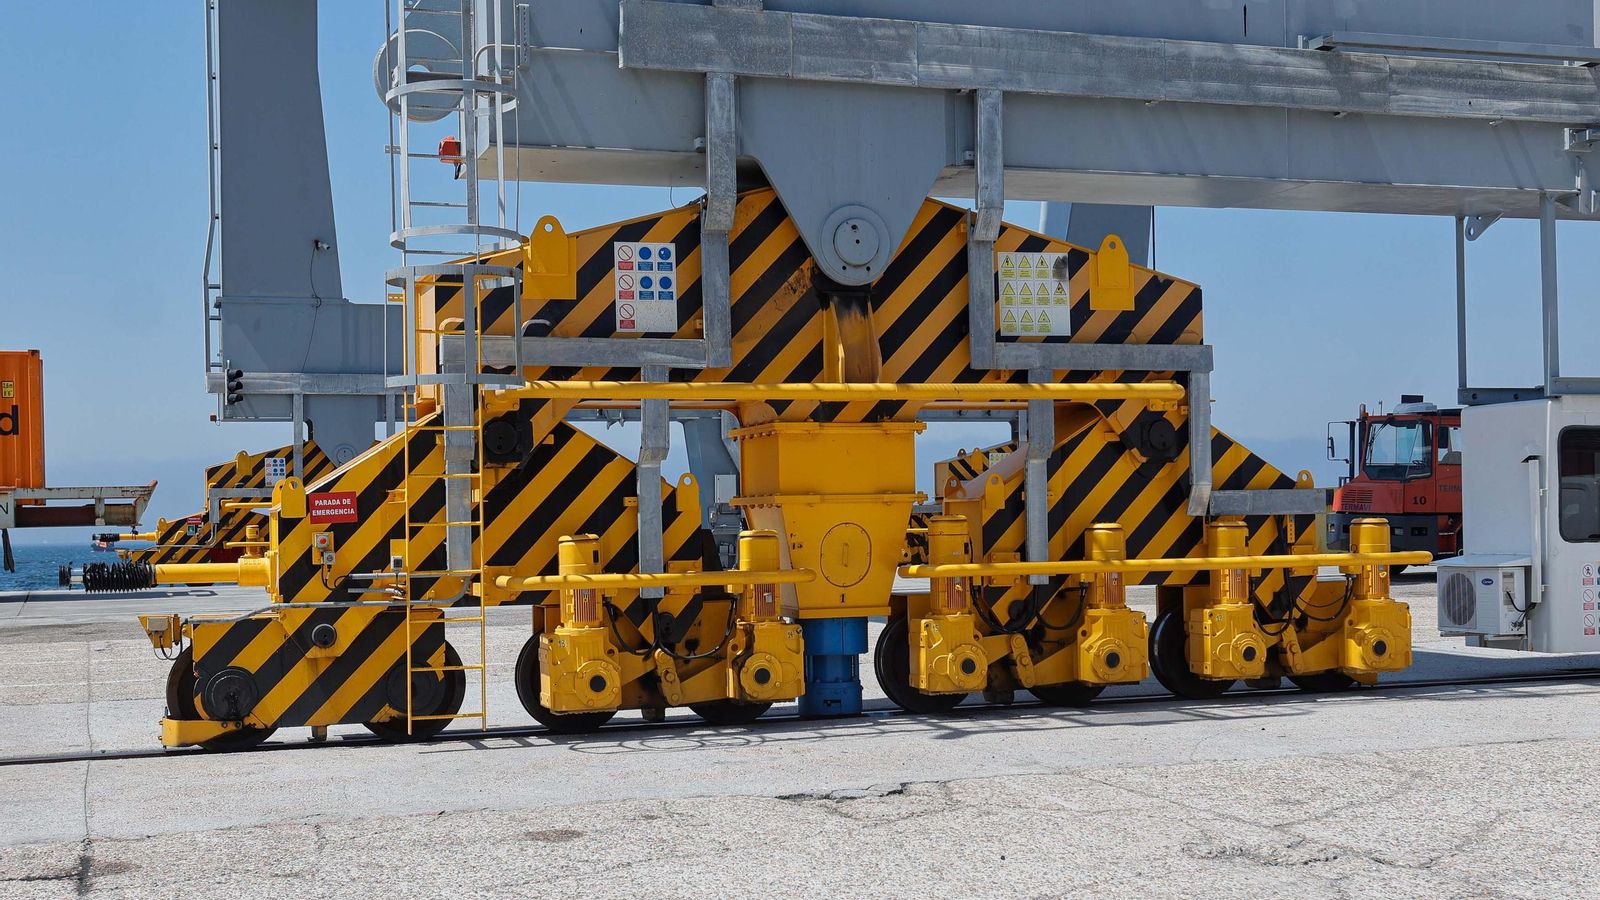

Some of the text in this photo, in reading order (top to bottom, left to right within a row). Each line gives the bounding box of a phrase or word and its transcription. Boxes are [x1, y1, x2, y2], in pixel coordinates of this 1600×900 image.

[1438, 484, 1462, 493] TERM
[1412, 496, 1427, 505] 10
[312, 508, 355, 516] EMERGENCIA
